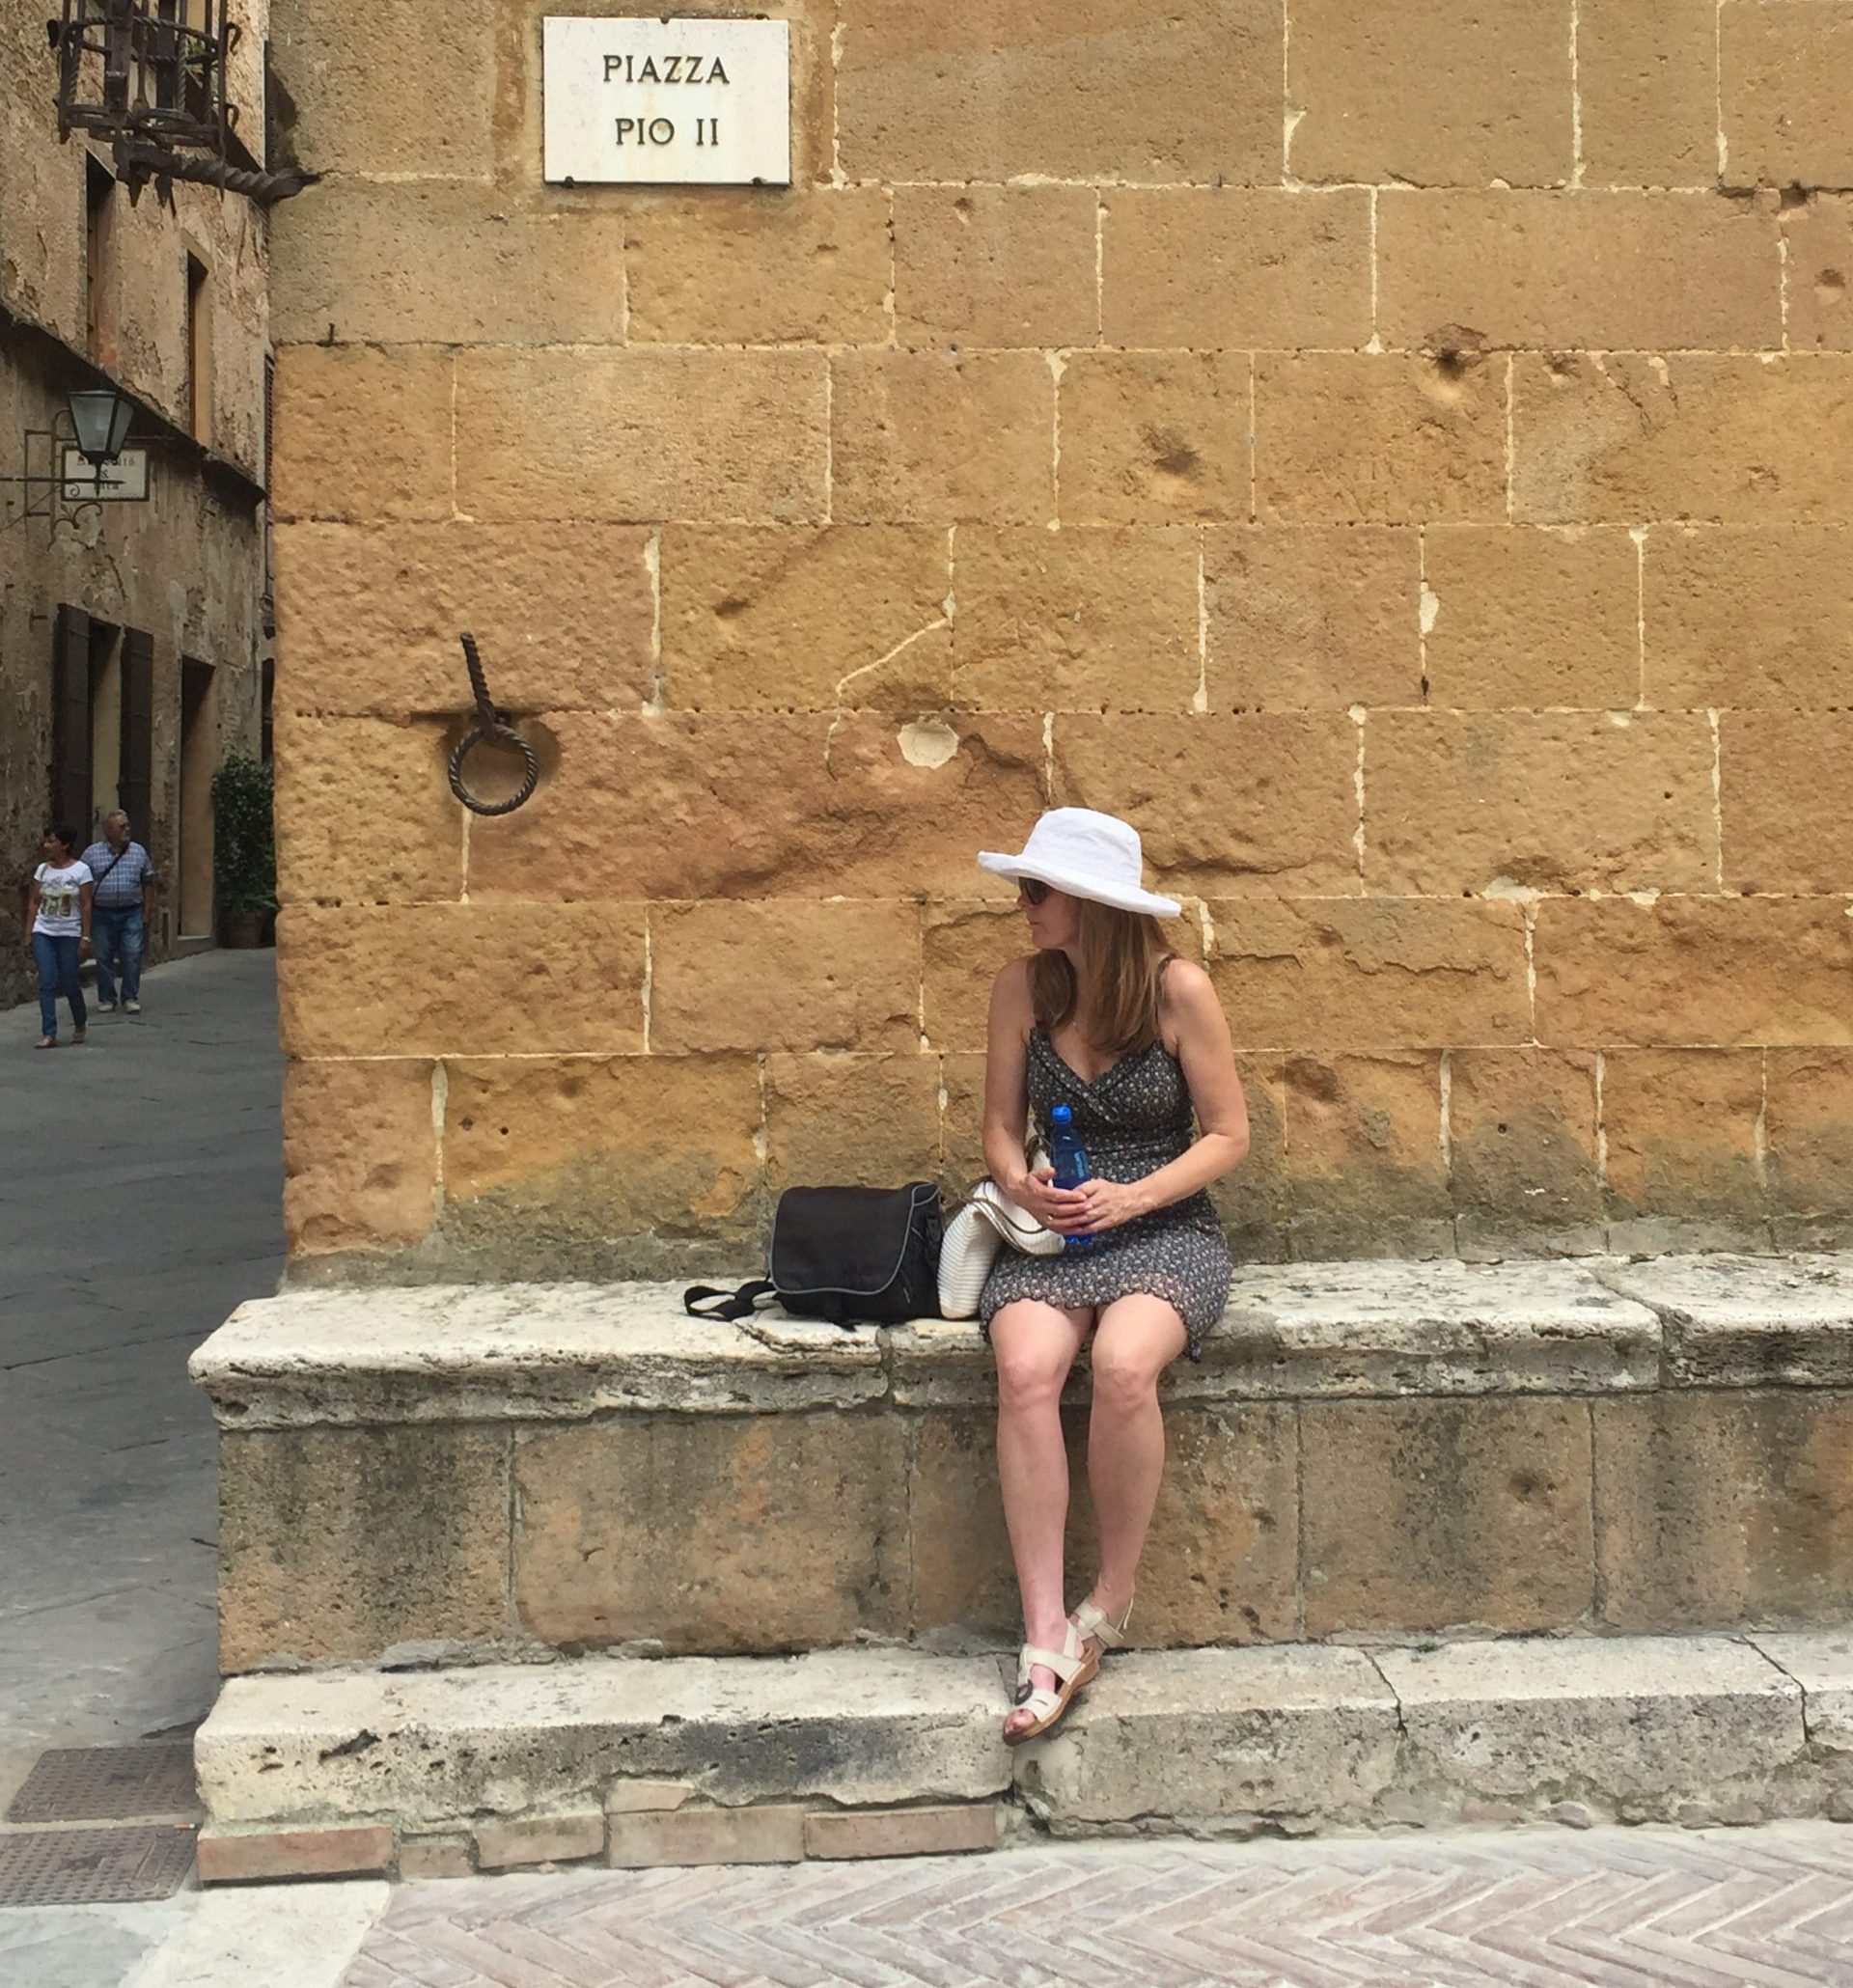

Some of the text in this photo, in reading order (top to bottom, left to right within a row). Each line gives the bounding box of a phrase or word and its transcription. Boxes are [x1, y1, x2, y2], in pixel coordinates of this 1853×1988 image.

[603, 55, 730, 84] PIAZZA
[615, 118, 719, 146] PIO II
